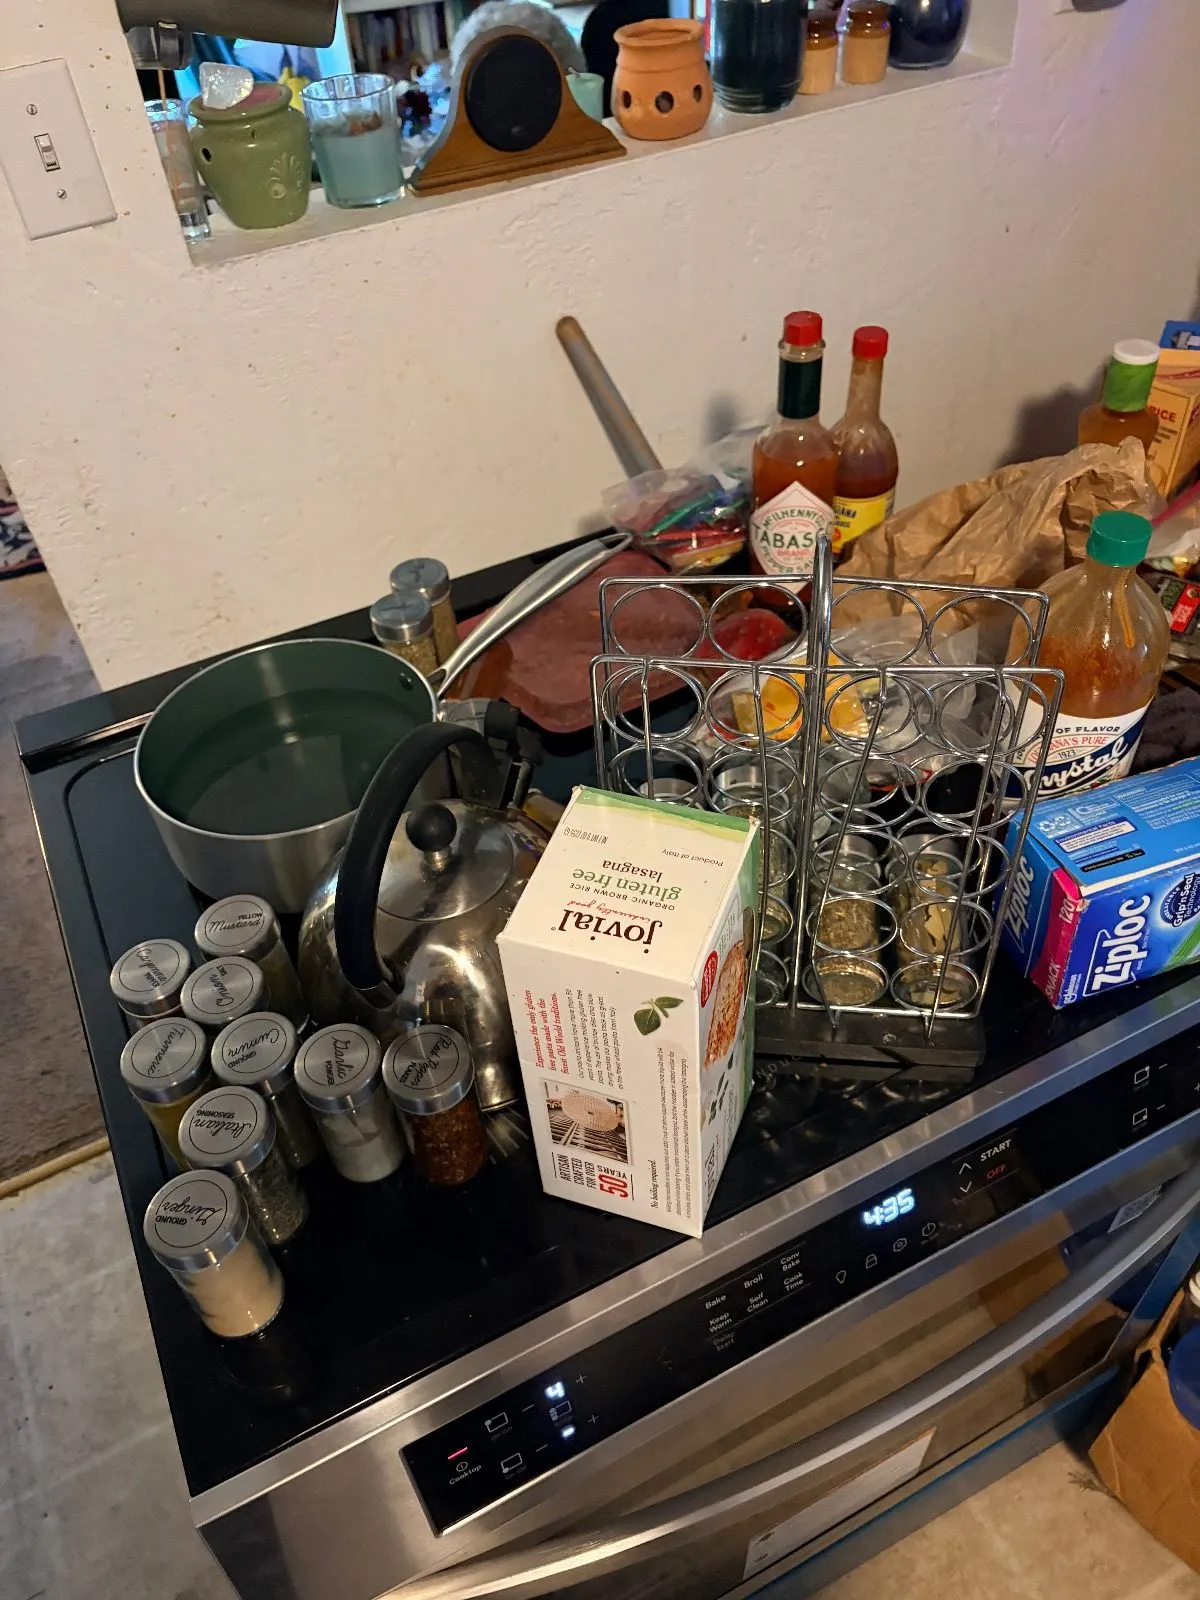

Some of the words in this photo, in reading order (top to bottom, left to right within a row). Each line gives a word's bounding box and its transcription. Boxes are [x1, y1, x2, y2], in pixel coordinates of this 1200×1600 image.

[752, 522, 825, 549] TABASC
[1081, 736, 1110, 745] PURE
[1059, 750, 1076, 759] 1923
[661, 848, 679, 858] Italy
[680, 852, 689, 860] of
[690, 855, 724, 867] Product
[572, 868, 611, 889] free
[603, 859, 663, 883] lasagna
[569, 882, 591, 893] RICE
[593, 887, 628, 901] BROWN
[617, 877, 682, 902] gluten
[567, 900, 596, 910] good
[631, 896, 675, 911] ORGANIC
[1184, 877, 1200, 918] Technology
[238, 912, 263, 920] YELLOW
[595, 902, 651, 923] inherently
[1059, 895, 1076, 924] 120
[209, 919, 262, 932] Mustard
[557, 909, 663, 953] jovial
[1092, 895, 1150, 990] Ziploc
[216, 965, 228, 976] SALT
[1045, 958, 1061, 999] SNACK
[144, 972, 161, 988] PEPPER
[210, 974, 234, 1006] Onion
[524, 990, 535, 1010] gluten
[537, 999, 545, 1008] the
[527, 1011, 537, 1024] only
[539, 1011, 549, 1023] with
[529, 1026, 538, 1035] the
[541, 1025, 551, 1042] made
[554, 1025, 564, 1043] World
[228, 1028, 280, 1057] Cumin
[430, 1036, 451, 1056] Red
[147, 1027, 186, 1076] Turmeric
[331, 1036, 354, 1079] Garlic
[532, 1037, 544, 1068] Experience
[546, 1044, 555, 1059] pasta
[557, 1046, 566, 1056] Old
[227, 1051, 257, 1068] GROUND
[548, 1061, 556, 1071] free
[325, 1060, 335, 1087] POWDER
[399, 1061, 417, 1084] FLAKES
[410, 1055, 441, 1087] Pepper
[196, 1109, 236, 1119] SEASONING
[193, 1118, 252, 1139] Italian
[980, 1139, 1011, 1162] START
[557, 1153, 571, 1182] ARTISAN
[571, 1157, 584, 1185] CRAFTED
[584, 1161, 595, 1177] OVER
[597, 1165, 627, 1180] YEARS
[985, 1164, 1007, 1179] OFF
[586, 1174, 597, 1189] FOR
[598, 1174, 629, 1198] 50
[650, 1184, 659, 1200] boiling
[163, 1196, 222, 1226] Ginger
[863, 1188, 915, 1226] 4:35
[156, 1215, 188, 1226] GROUND
[780, 1252, 800, 1265] Conv
[782, 1259, 800, 1271] Bake
[743, 1273, 764, 1288] Broil
[783, 1272, 803, 1285] Cook
[785, 1279, 804, 1291] Time
[705, 1294, 727, 1309] Bake
[747, 1298, 769, 1312] Clean
[749, 1291, 764, 1304] Self
[709, 1312, 730, 1326] Keep
[709, 1318, 732, 1333] Warm
[544, 1381, 566, 1399] 4
[449, 1465, 482, 1485] Cooktop
